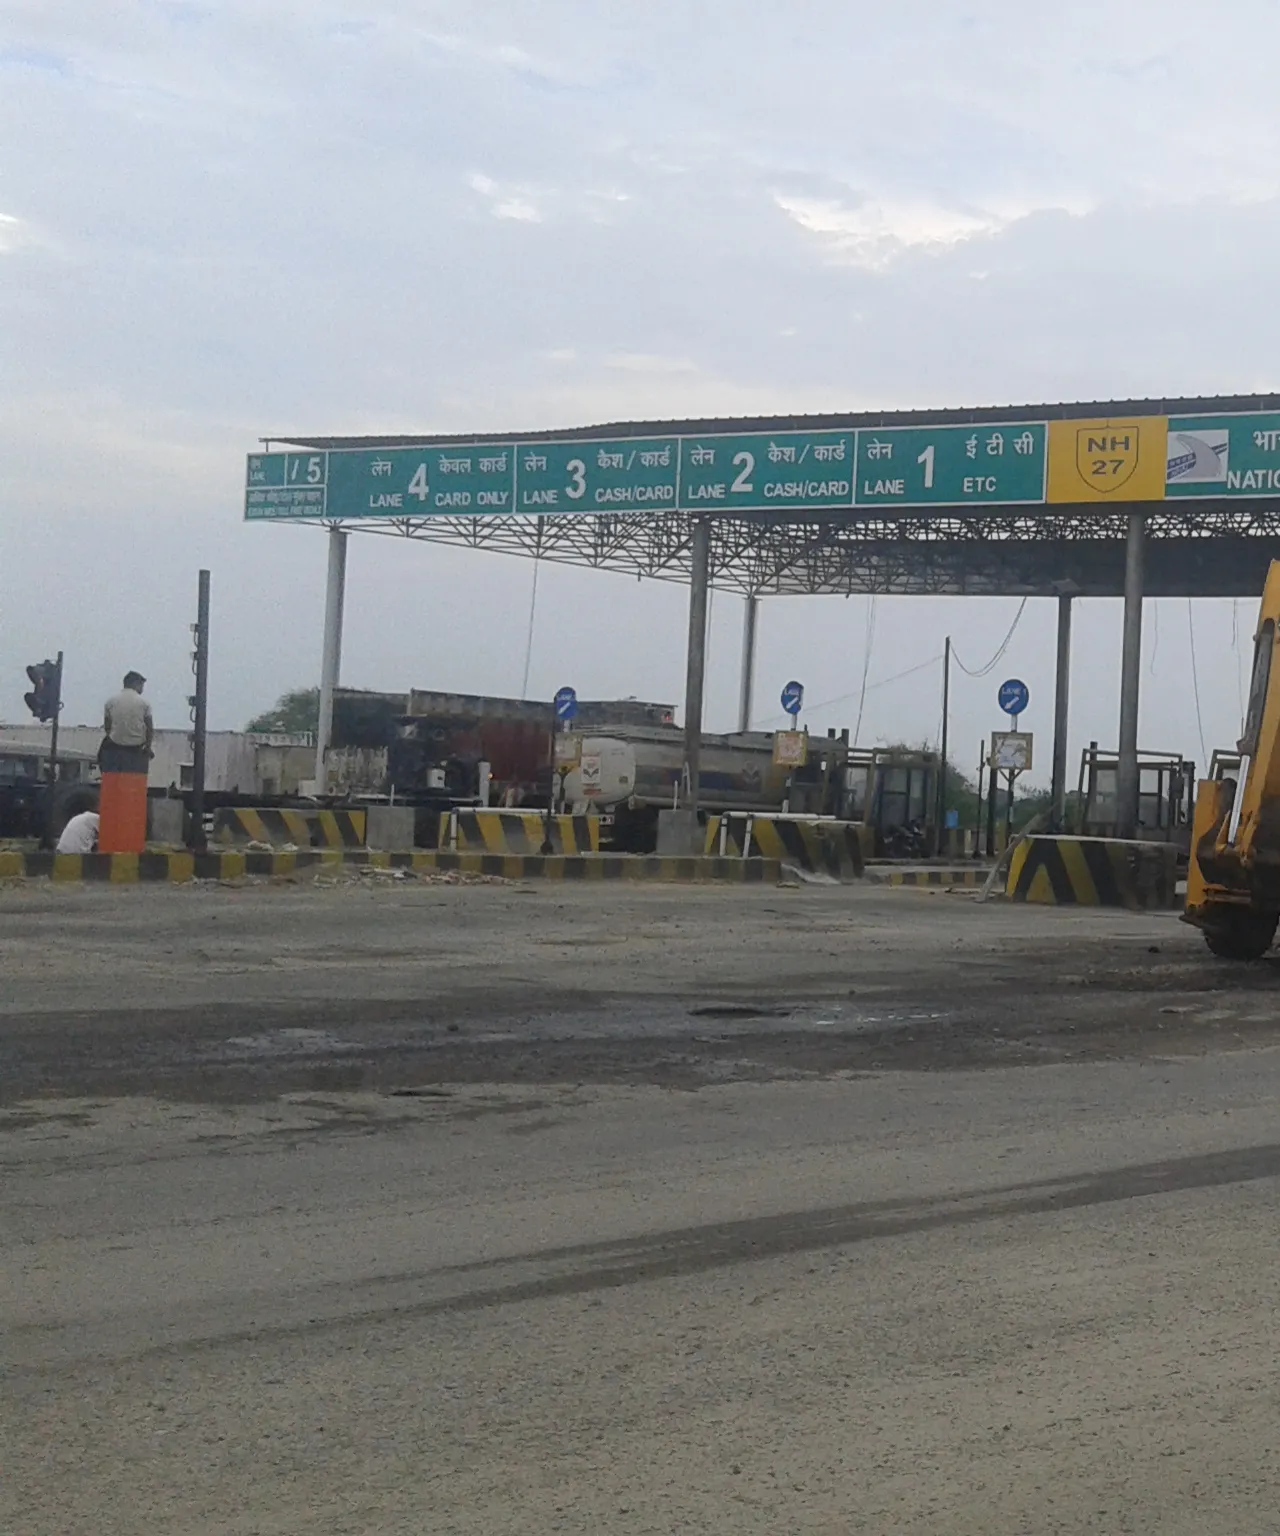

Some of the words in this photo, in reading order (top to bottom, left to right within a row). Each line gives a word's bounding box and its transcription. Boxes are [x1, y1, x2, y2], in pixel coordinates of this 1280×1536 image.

[814, 439, 846, 461] कार्ड
[866, 438, 893, 460] लेन
[965, 434, 978, 459] ई
[985, 432, 1004, 456] टी
[1012, 431, 1034, 455] सी
[1088, 436, 1129, 452] NH
[438, 454, 471, 474] केवल
[478, 451, 508, 473] कार्ड
[524, 451, 547, 472] लेन
[640, 444, 671, 467] कार्ड
[691, 444, 715, 466] लेन
[307, 456, 321, 483] 5
[371, 457, 392, 477] लेन
[730, 451, 755, 493] 2
[917, 445, 936, 488] 1
[1092, 459, 1125, 475] 27
[408, 462, 430, 501] 4
[565, 459, 586, 499] 3
[764, 479, 849, 498] CASH/CARD
[864, 479, 905, 495] LANE
[963, 476, 997, 493] ETC
[370, 493, 403, 508] LANE
[435, 491, 471, 506] CARD
[477, 491, 509, 506] ONLY
[523, 489, 558, 505] LANE
[595, 485, 673, 503] CASH/CARD
[688, 483, 725, 499] LANE
